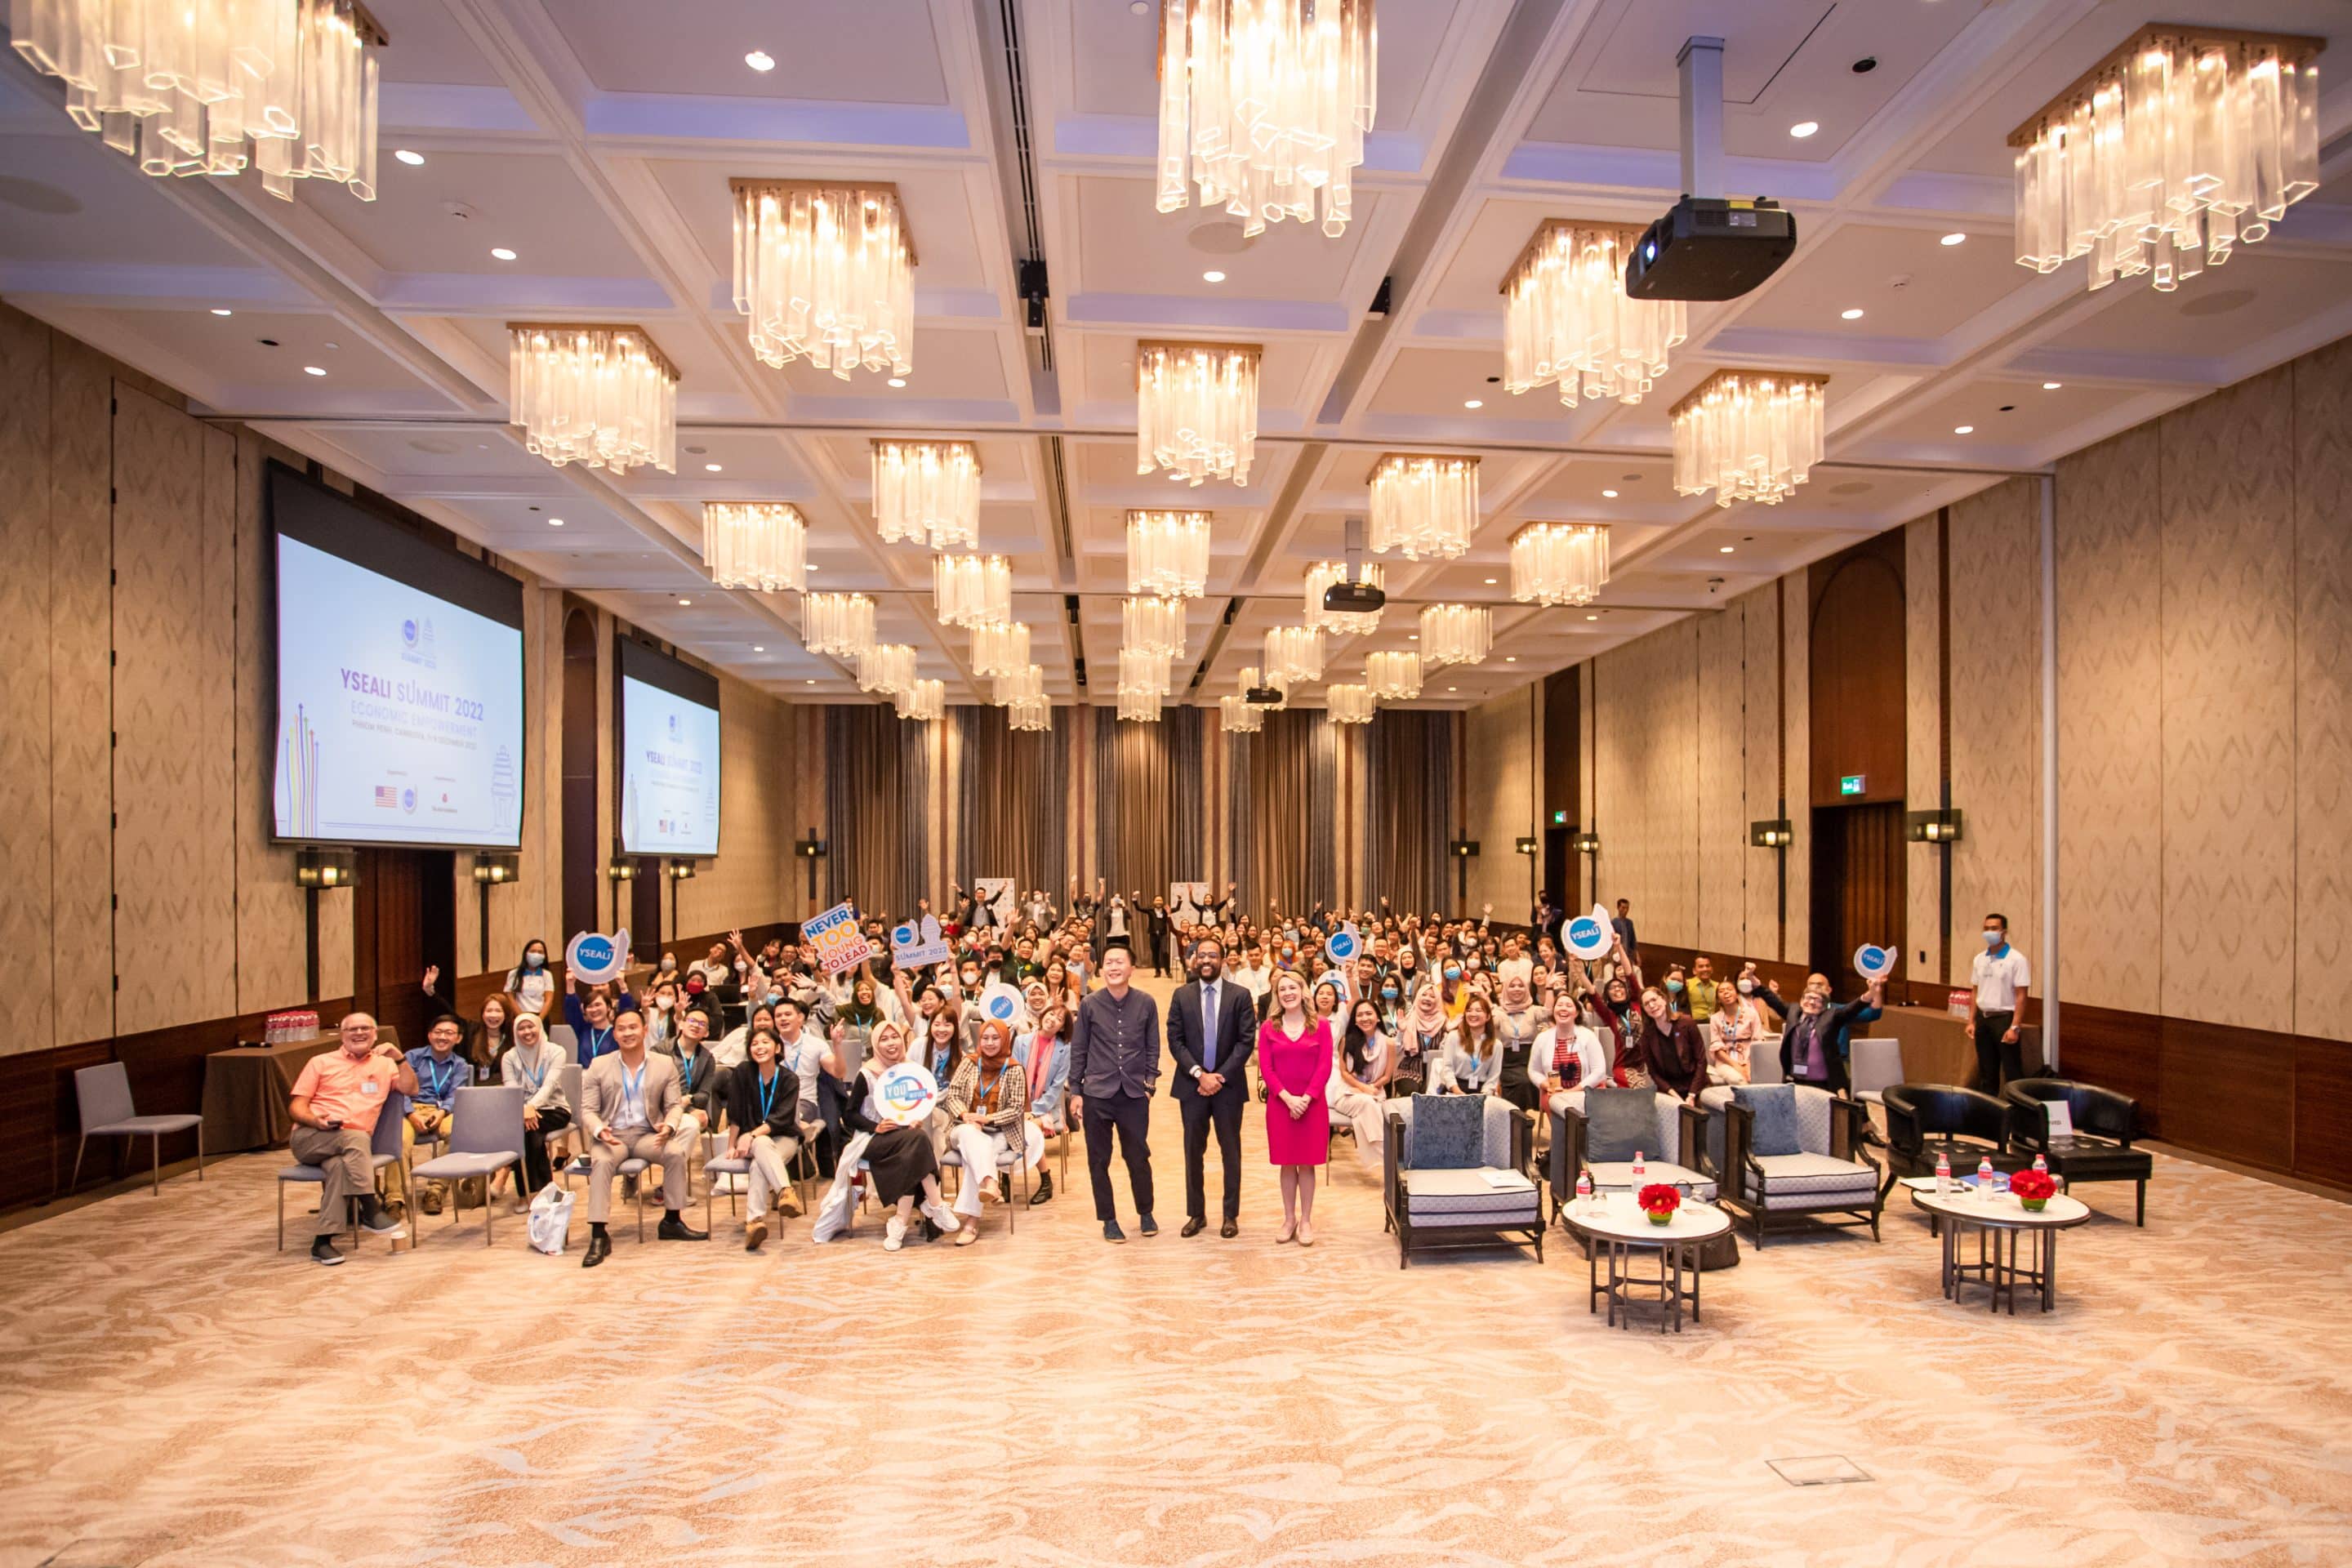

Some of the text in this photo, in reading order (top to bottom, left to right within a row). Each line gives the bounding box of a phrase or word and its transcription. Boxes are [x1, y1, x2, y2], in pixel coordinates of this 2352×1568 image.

[341, 668, 483, 721] YSEALI SUMMIT 2022
[351, 699, 408, 724] ECONOMIC
[805, 909, 850, 938] NEVER
[1571, 928, 1599, 940] YSEALI
[811, 921, 856, 951] TOO
[1333, 939, 1352, 951] YSEALI
[579, 947, 611, 960] YSEALI
[821, 936, 862, 961] YOUNG
[825, 945, 867, 969] TO LEAD
[896, 947, 947, 961] SUMMIT 2022
[886, 1083, 906, 1098] YOU
